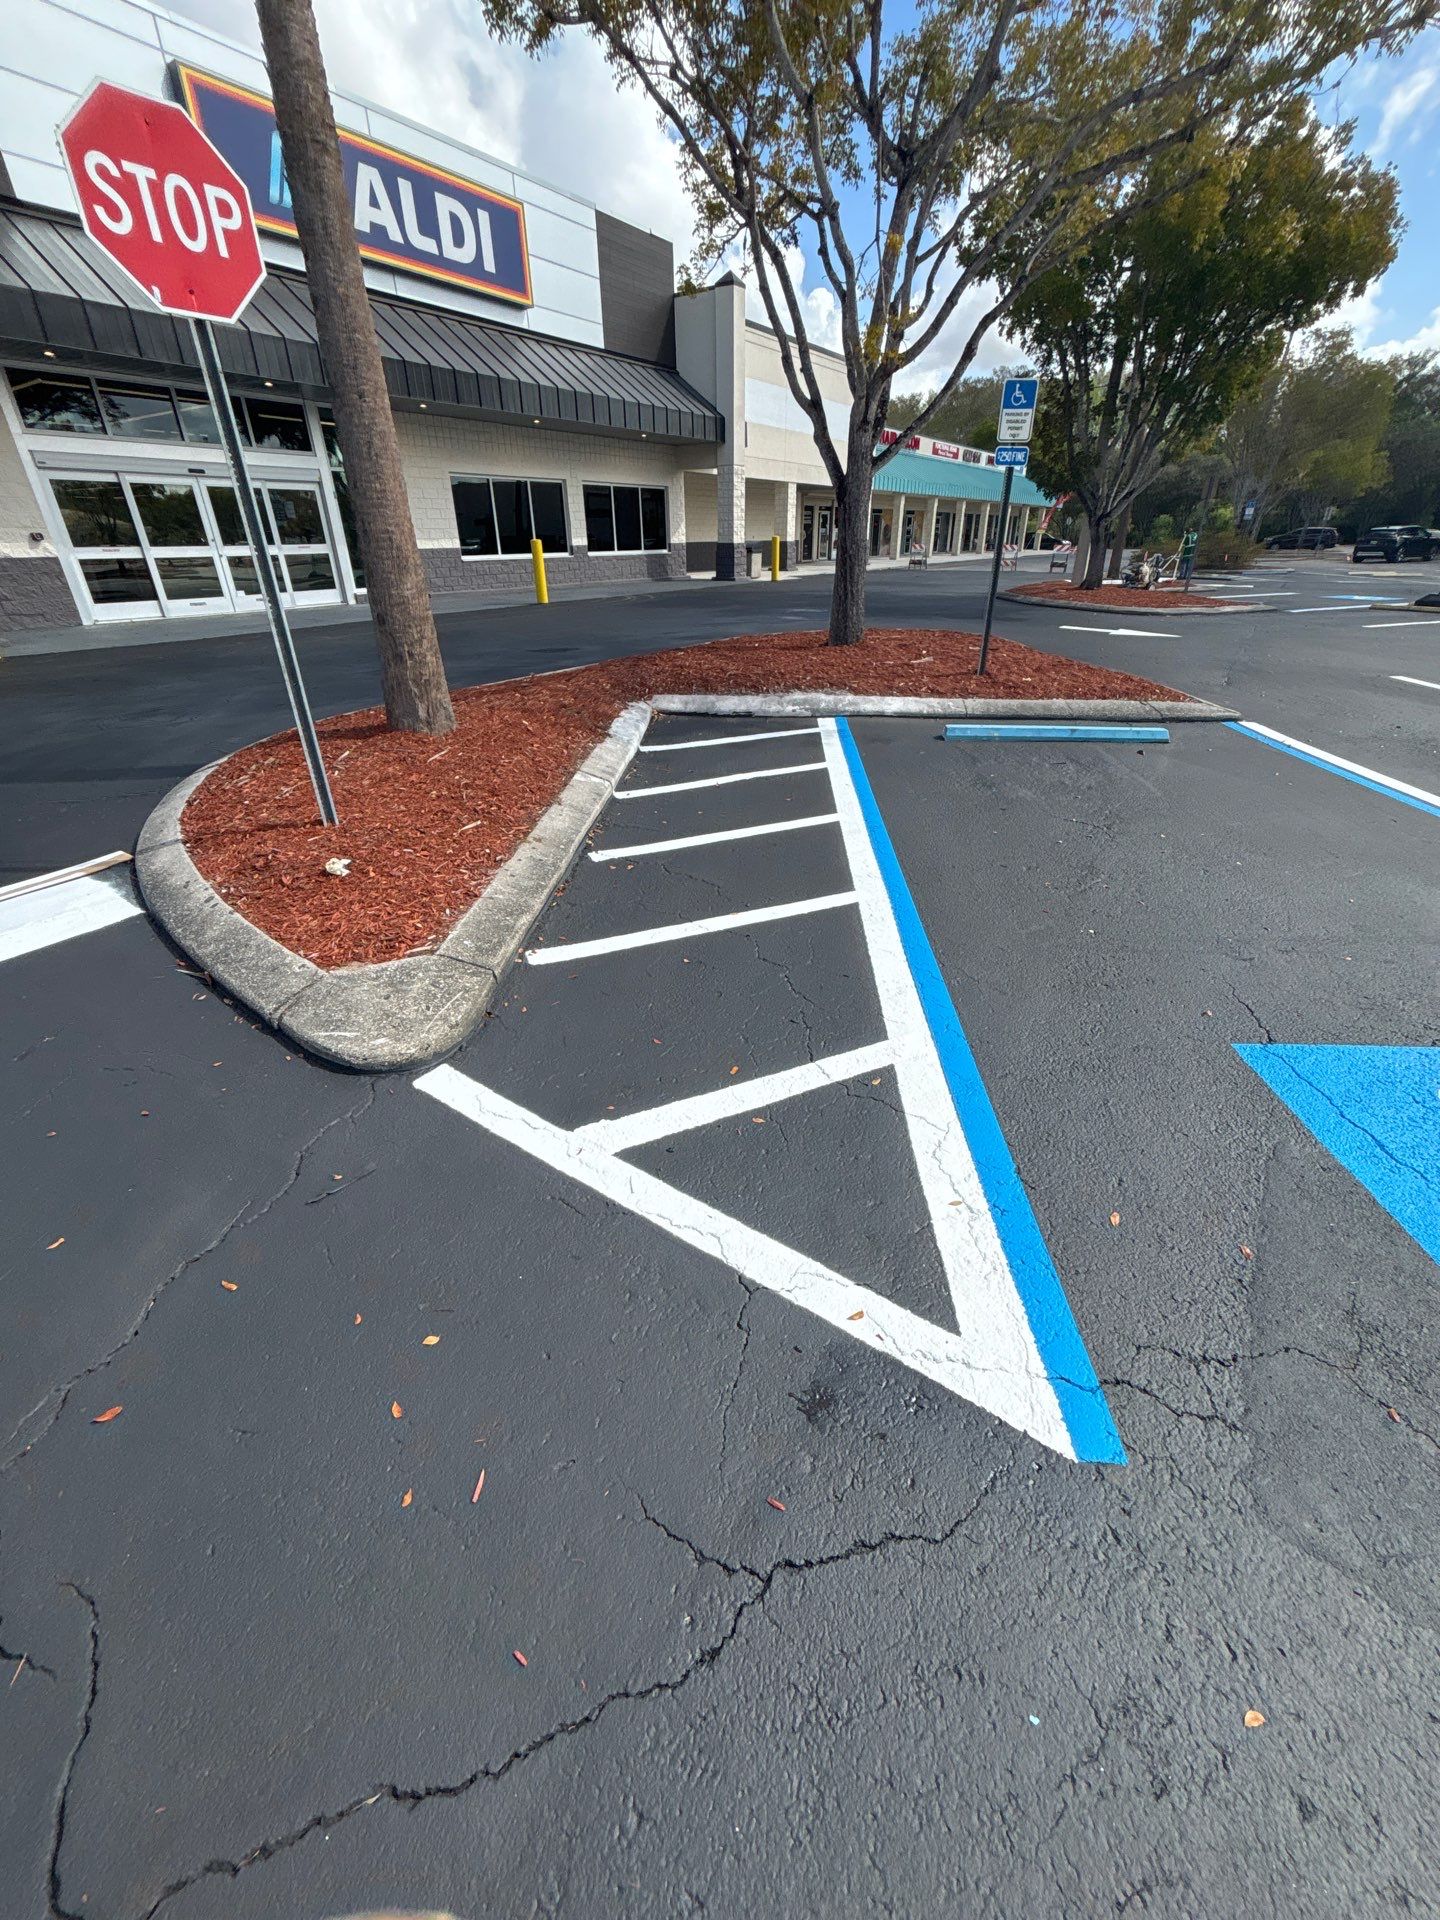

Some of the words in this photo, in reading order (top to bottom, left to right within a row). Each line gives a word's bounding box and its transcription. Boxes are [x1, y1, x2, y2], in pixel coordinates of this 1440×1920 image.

[84, 149, 243, 259] STOP
[354, 161, 496, 275] ALDI
[998, 451, 1012, 462] $250
[1012, 451, 1027, 462] FINE
